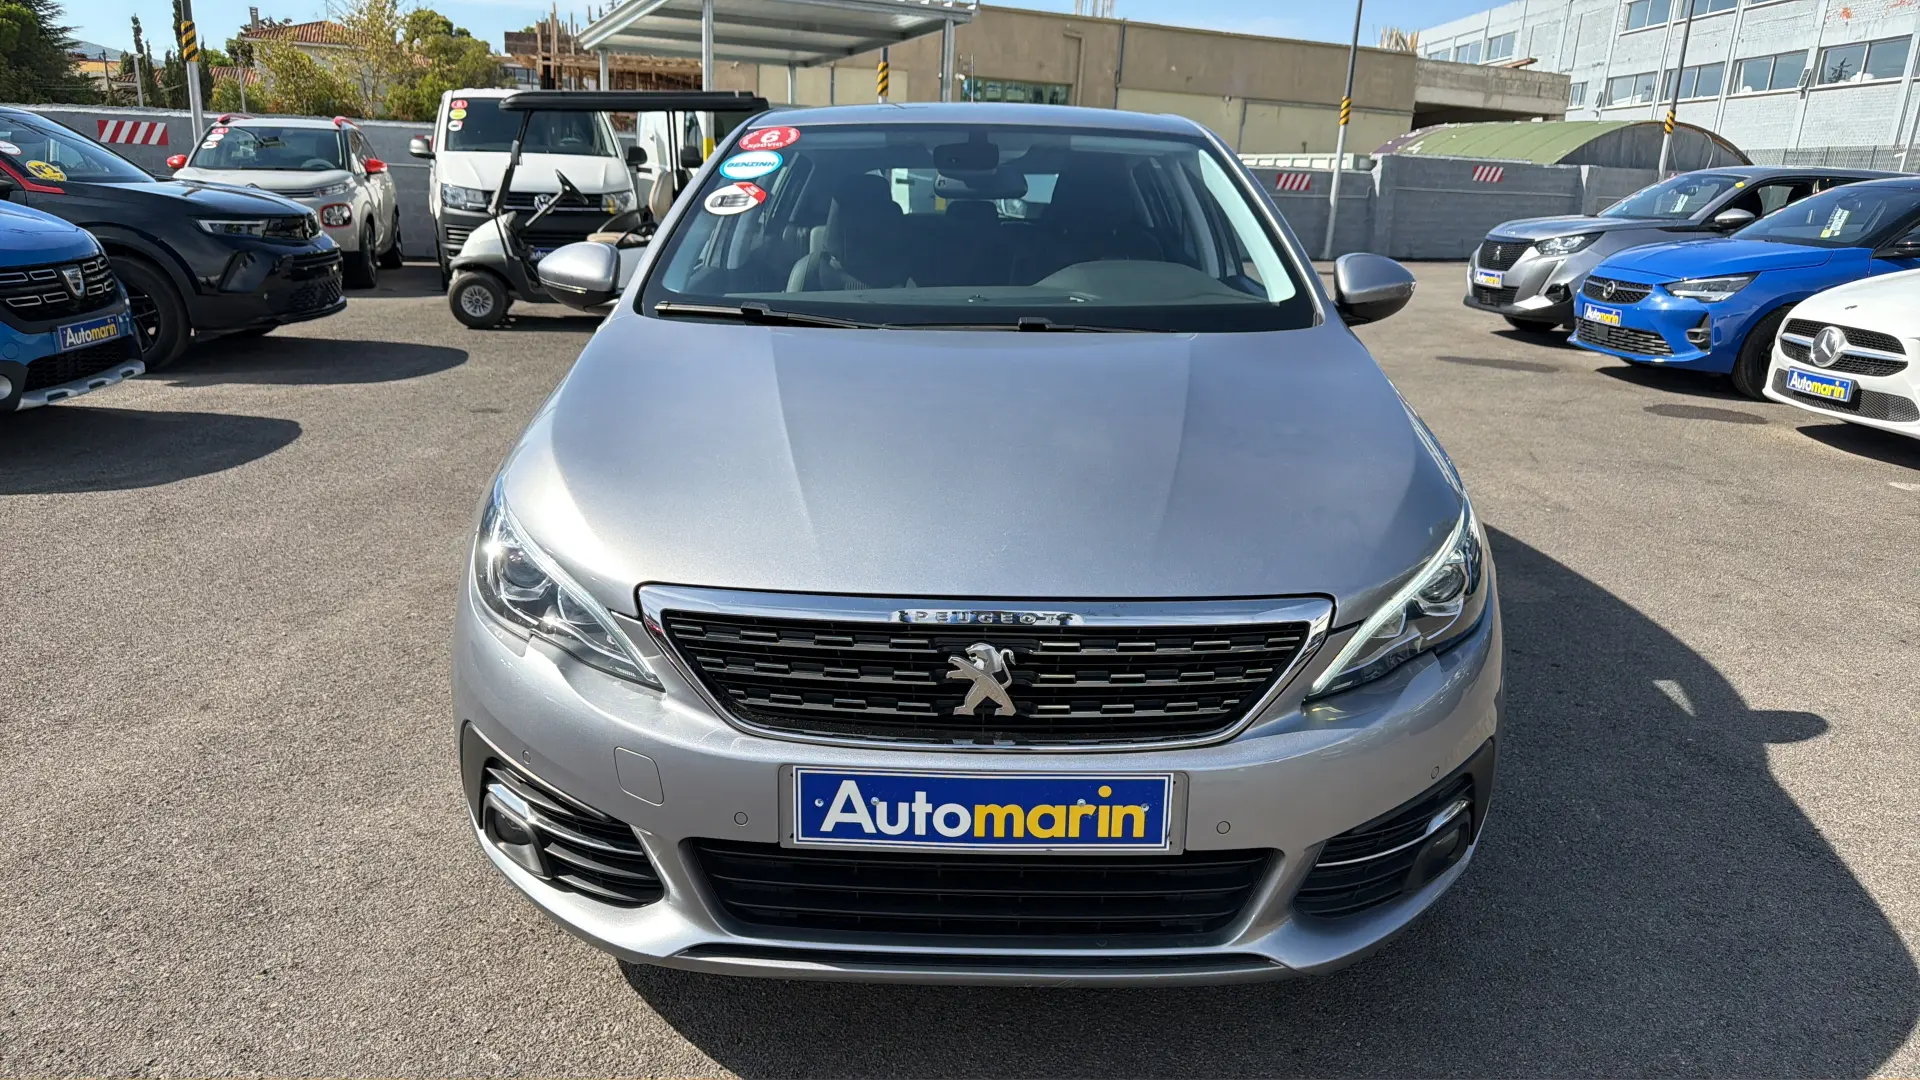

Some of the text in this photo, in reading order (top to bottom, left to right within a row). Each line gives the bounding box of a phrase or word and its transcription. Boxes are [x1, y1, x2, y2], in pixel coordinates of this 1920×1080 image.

[760, 130, 781, 143] 6
[1586, 305, 1619, 325] Automarin
[66, 318, 117, 347] Automarin
[1790, 371, 1845, 399] Automarin
[914, 610, 1057, 624] PEUGEOT
[819, 779, 1145, 839] Automarin
